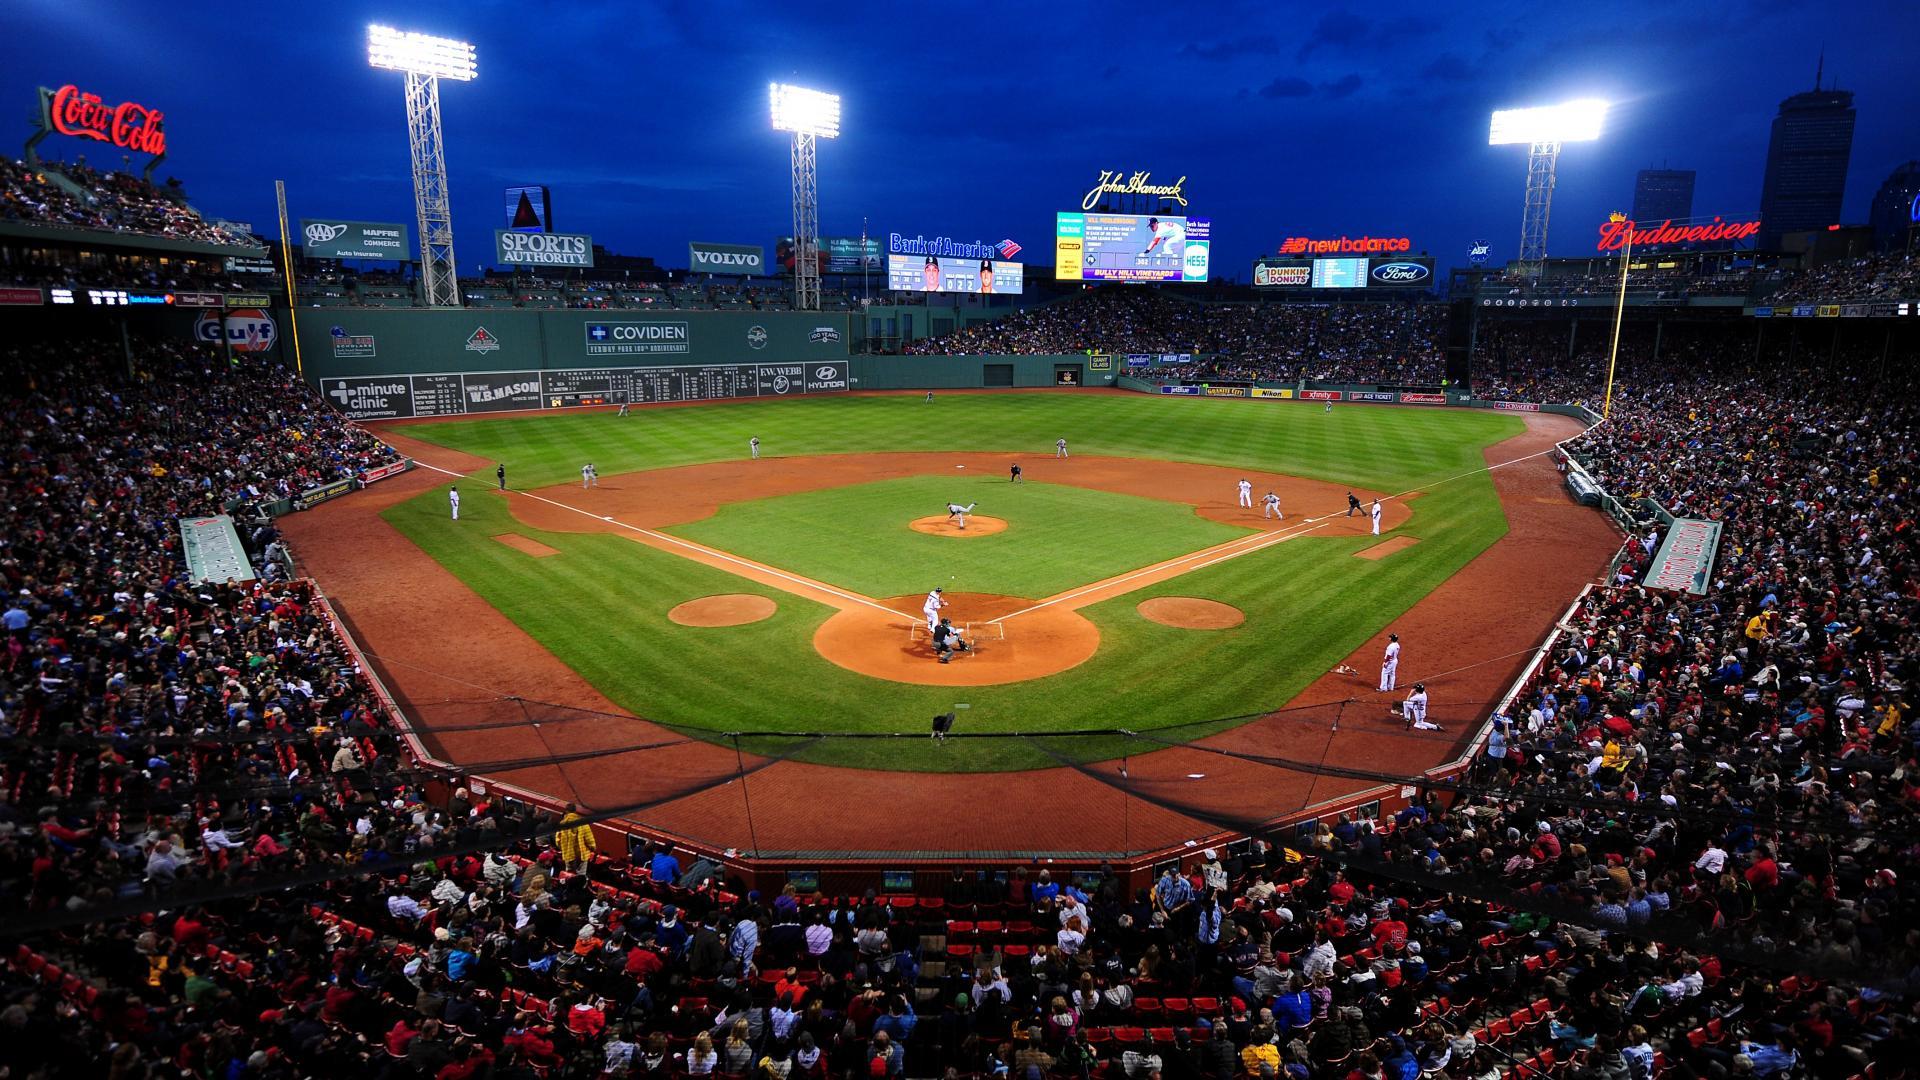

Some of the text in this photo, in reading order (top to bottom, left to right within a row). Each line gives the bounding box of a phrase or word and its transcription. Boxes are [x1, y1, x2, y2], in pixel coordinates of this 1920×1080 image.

[1082, 170, 1188, 210] John Hancock
[310, 225, 330, 241] AAA
[363, 229, 400, 237] MAPFRE
[1597, 216, 1761, 251] Budweiser
[364, 240, 401, 248] COMMERCE
[502, 233, 586, 254] SPORTS
[890, 232, 995, 259] Bank of America
[504, 251, 586, 264] AUTHORITY
[694, 251, 760, 266] VOLVO
[1187, 256, 1206, 266] HESS
[1270, 268, 1309, 276] DUNKIN'
[1383, 265, 1418, 280] Ford
[202, 323, 270, 340] Gulf
[613, 326, 685, 340] COVIDIEN
[356, 382, 406, 396] minute
[808, 380, 845, 389] HYUNDAI
[1309, 391, 1332, 399] xfinity
[1403, 395, 1445, 403] Budweiser
[350, 396, 388, 409] clinic
[344, 410, 397, 419] CVS/pharmacy
